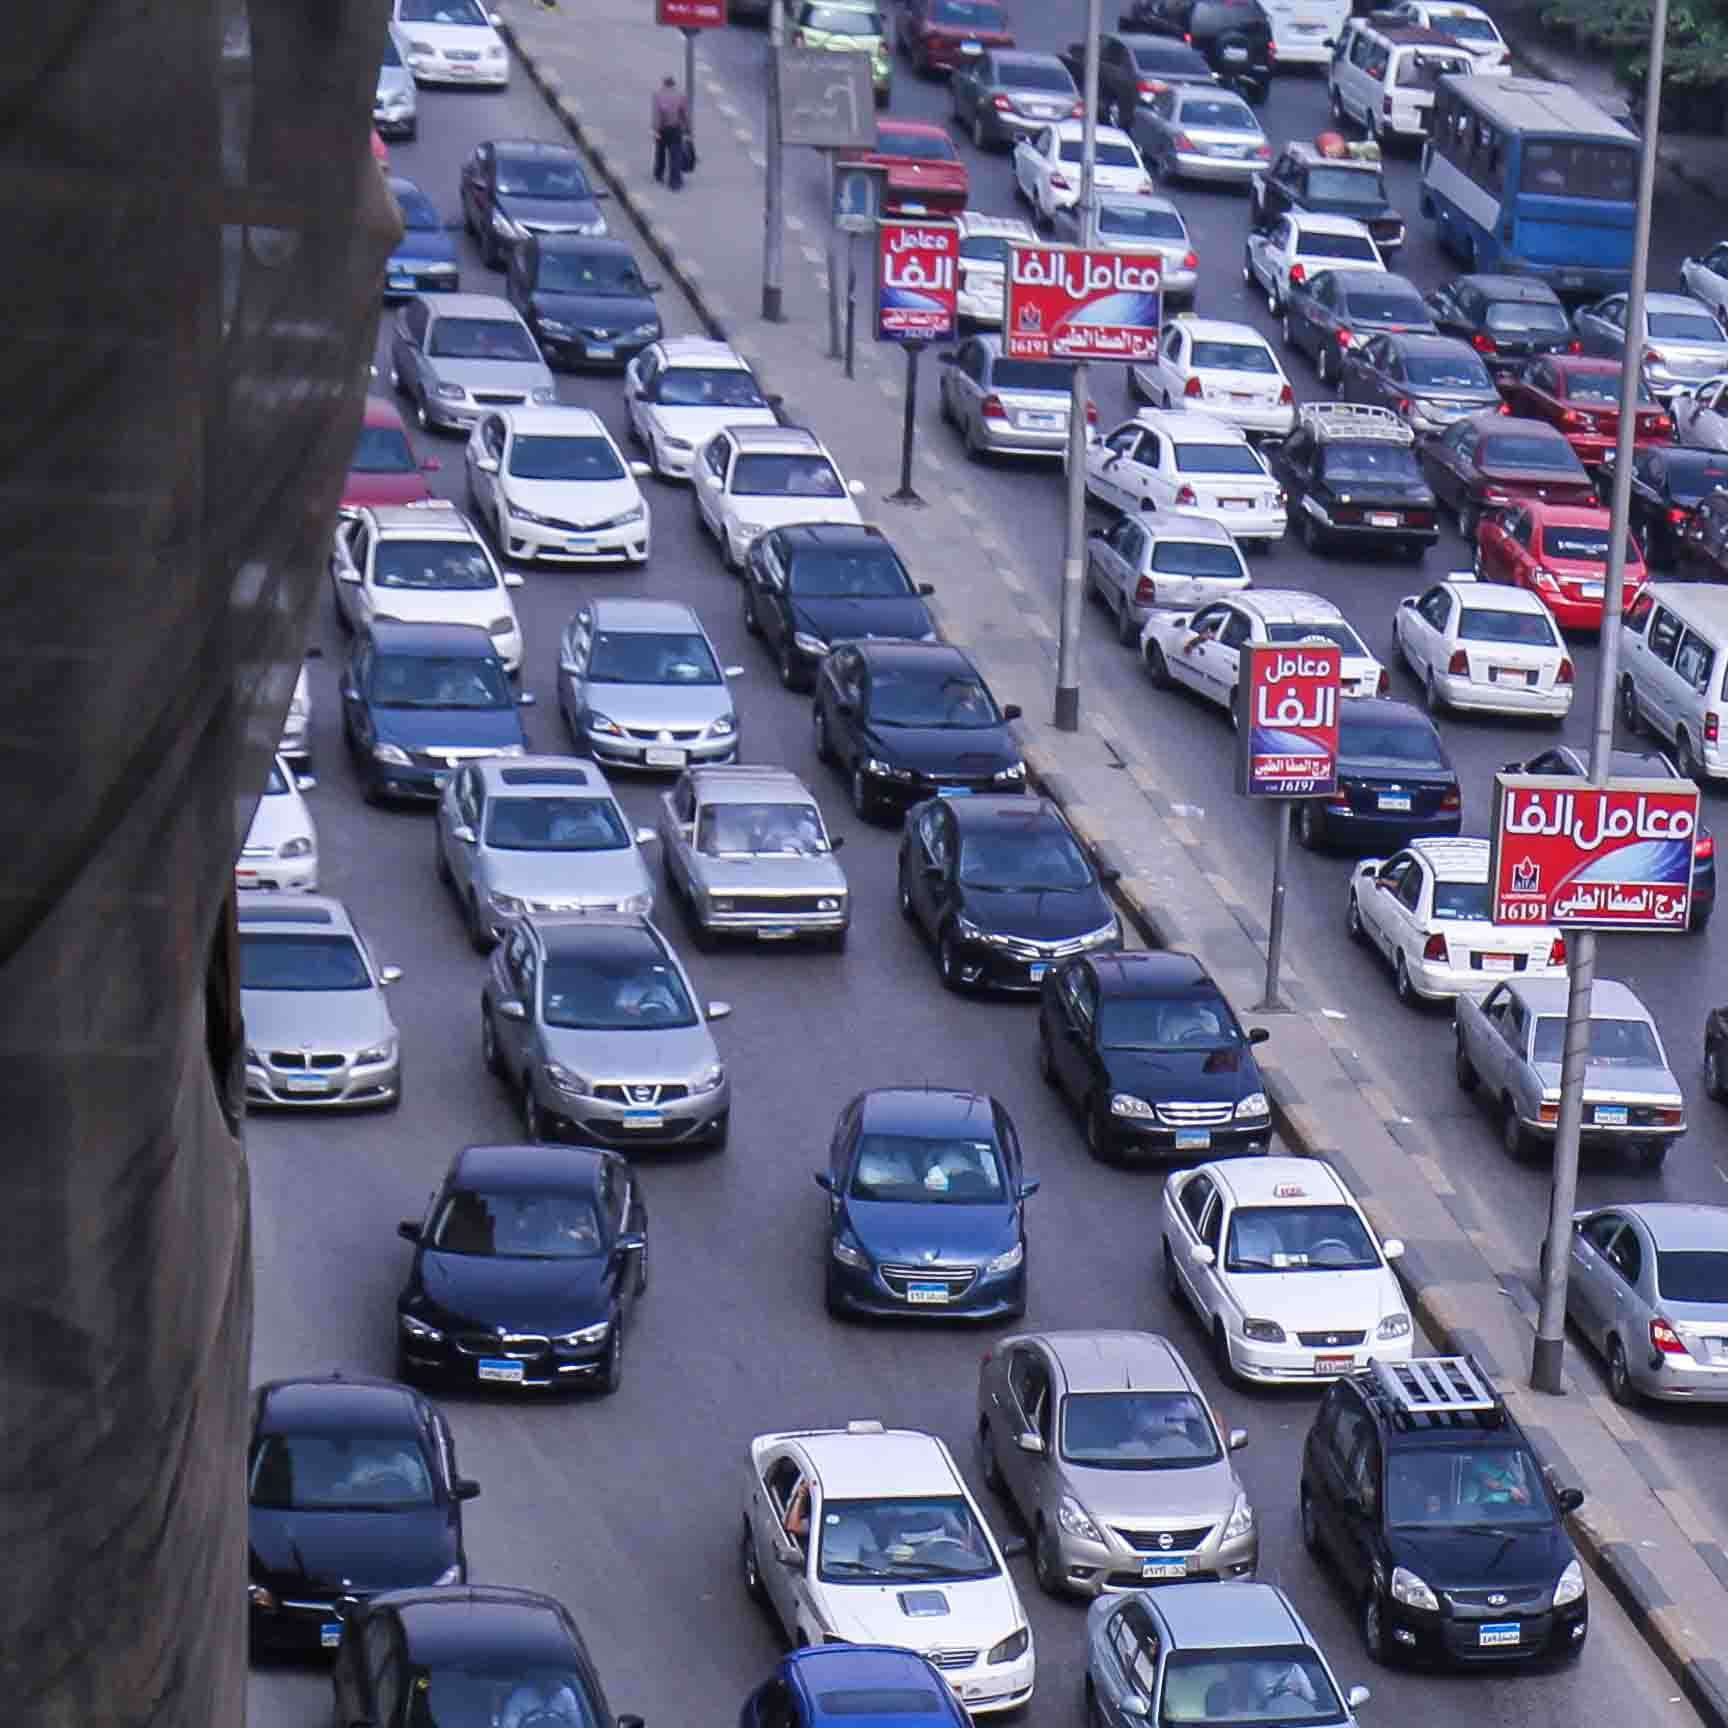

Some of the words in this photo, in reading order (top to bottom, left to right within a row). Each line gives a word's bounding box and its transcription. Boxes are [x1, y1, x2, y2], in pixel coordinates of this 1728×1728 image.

[884, 253, 952, 289] الفا
[1012, 250, 1065, 287] الفا
[1065, 255, 1160, 299] معامل
[1265, 654, 1331, 684] معامل
[1257, 685, 1335, 728] الفا
[1505, 792, 1574, 836] الفا
[1573, 795, 1694, 850] معامل
[1499, 902, 1547, 921] 16191
[1608, 884, 1654, 912] الصفا
[1654, 893, 1687, 919] برج
